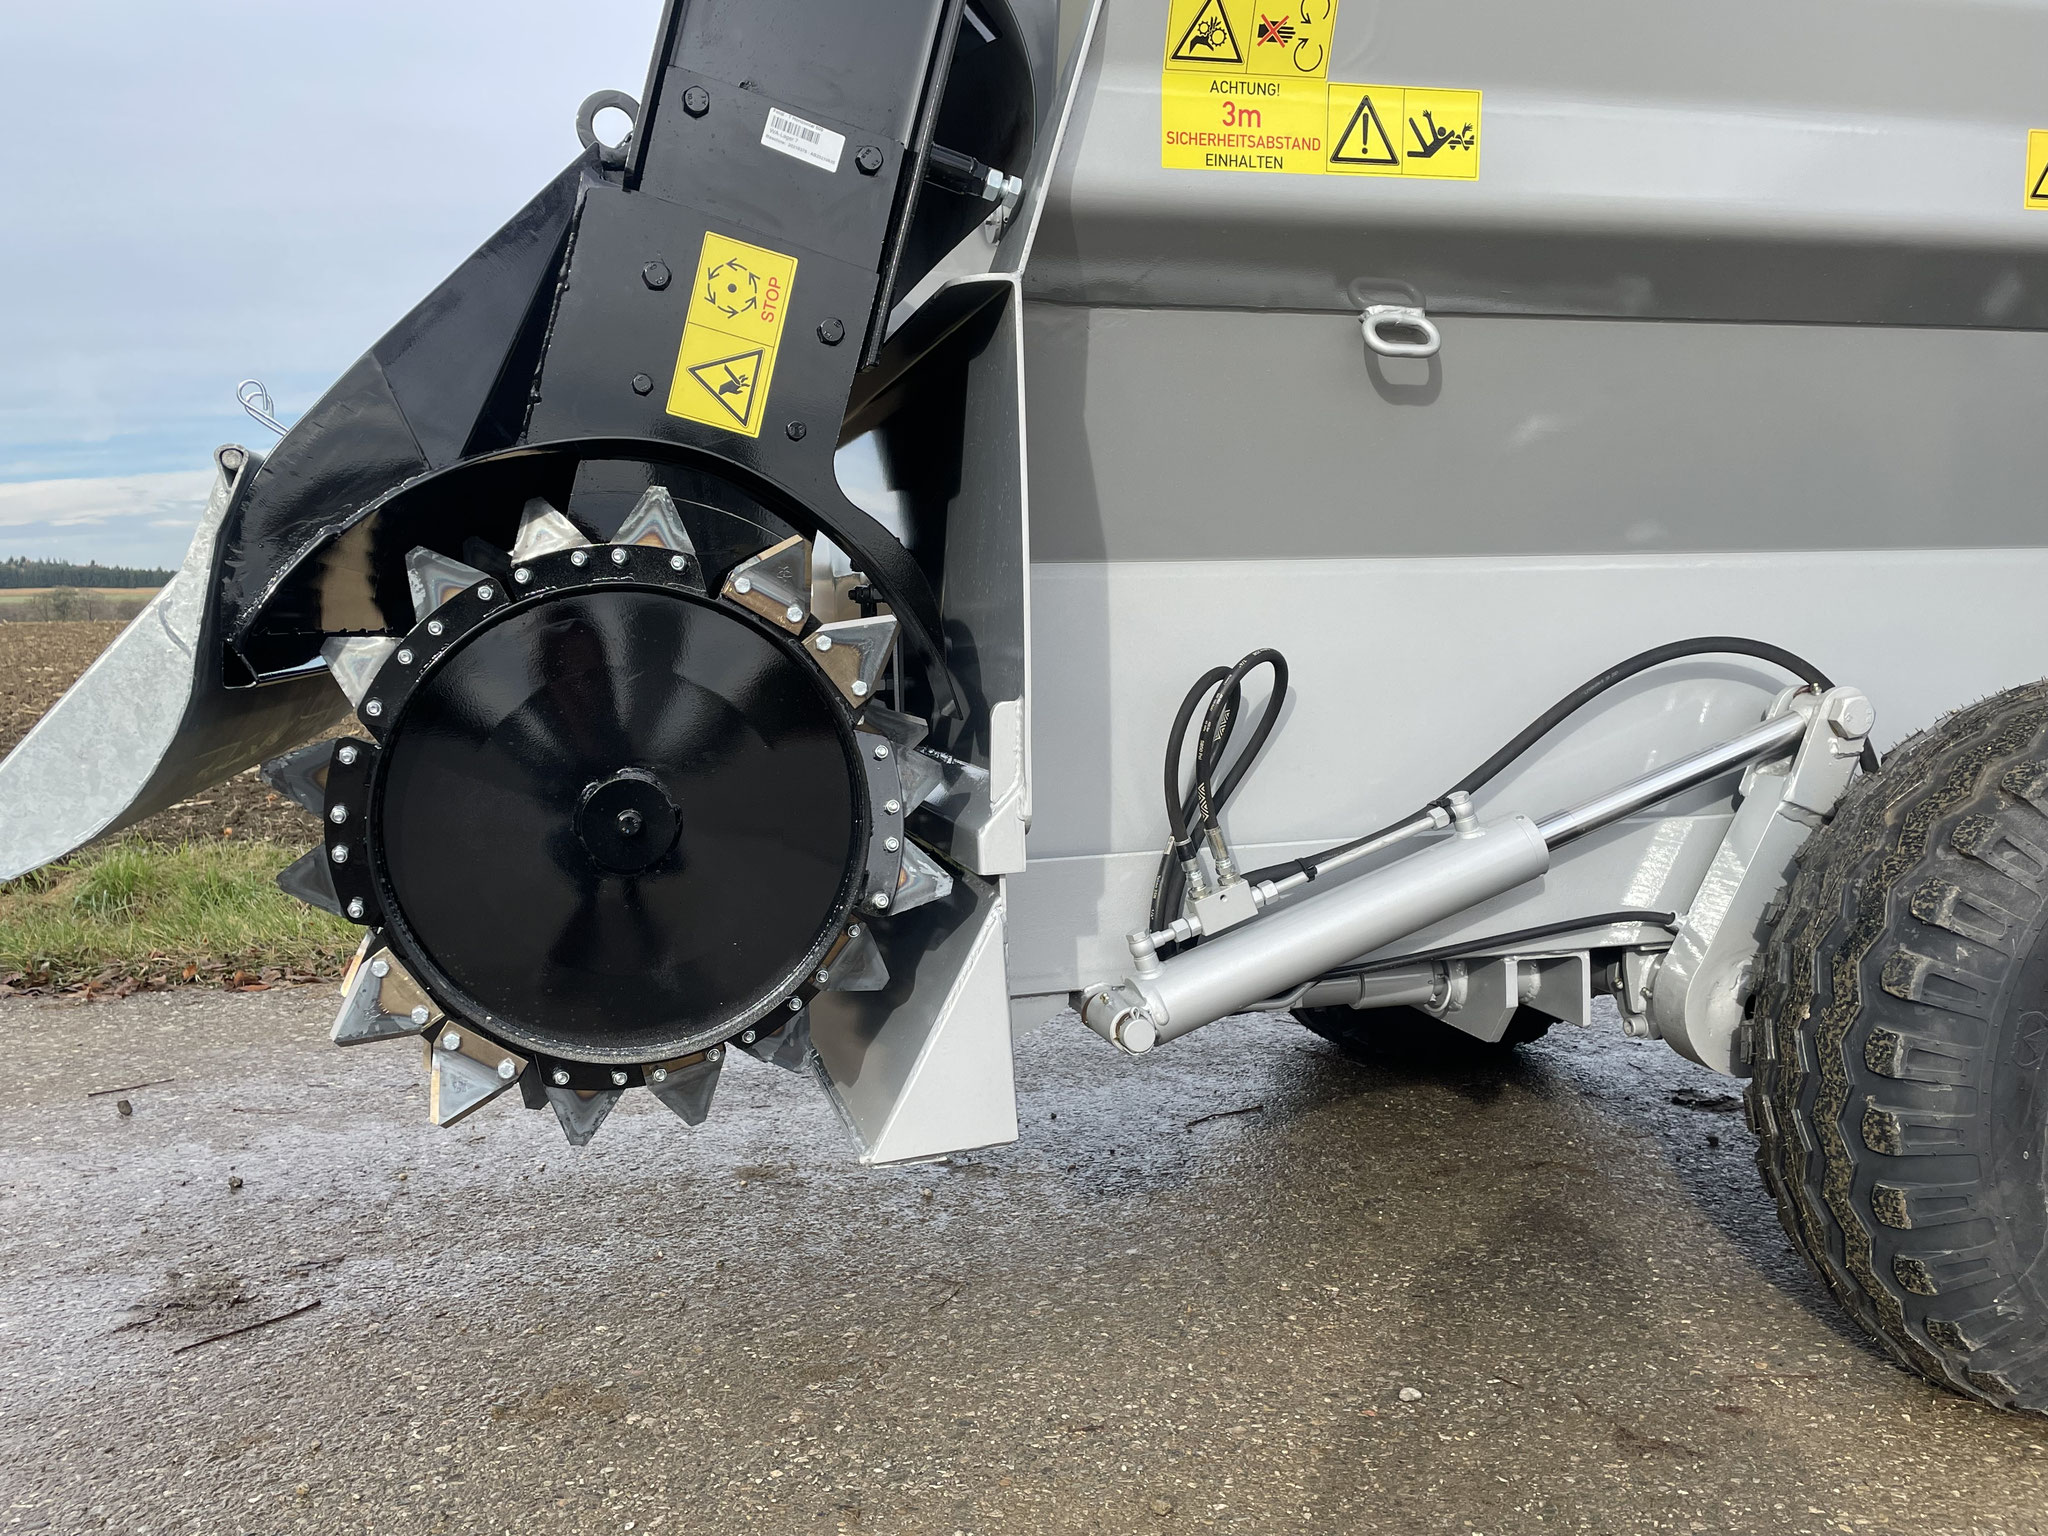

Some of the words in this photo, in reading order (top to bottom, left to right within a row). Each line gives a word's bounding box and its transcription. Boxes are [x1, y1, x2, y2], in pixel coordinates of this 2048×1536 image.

[1209, 79, 1281, 97] ACHTUNG!
[1221, 101, 1262, 128] 3m
[1166, 131, 1321, 152] SICHERHEITSABSTAND
[1205, 153, 1284, 169] EINHALTEN
[760, 277, 782, 323] STOP
